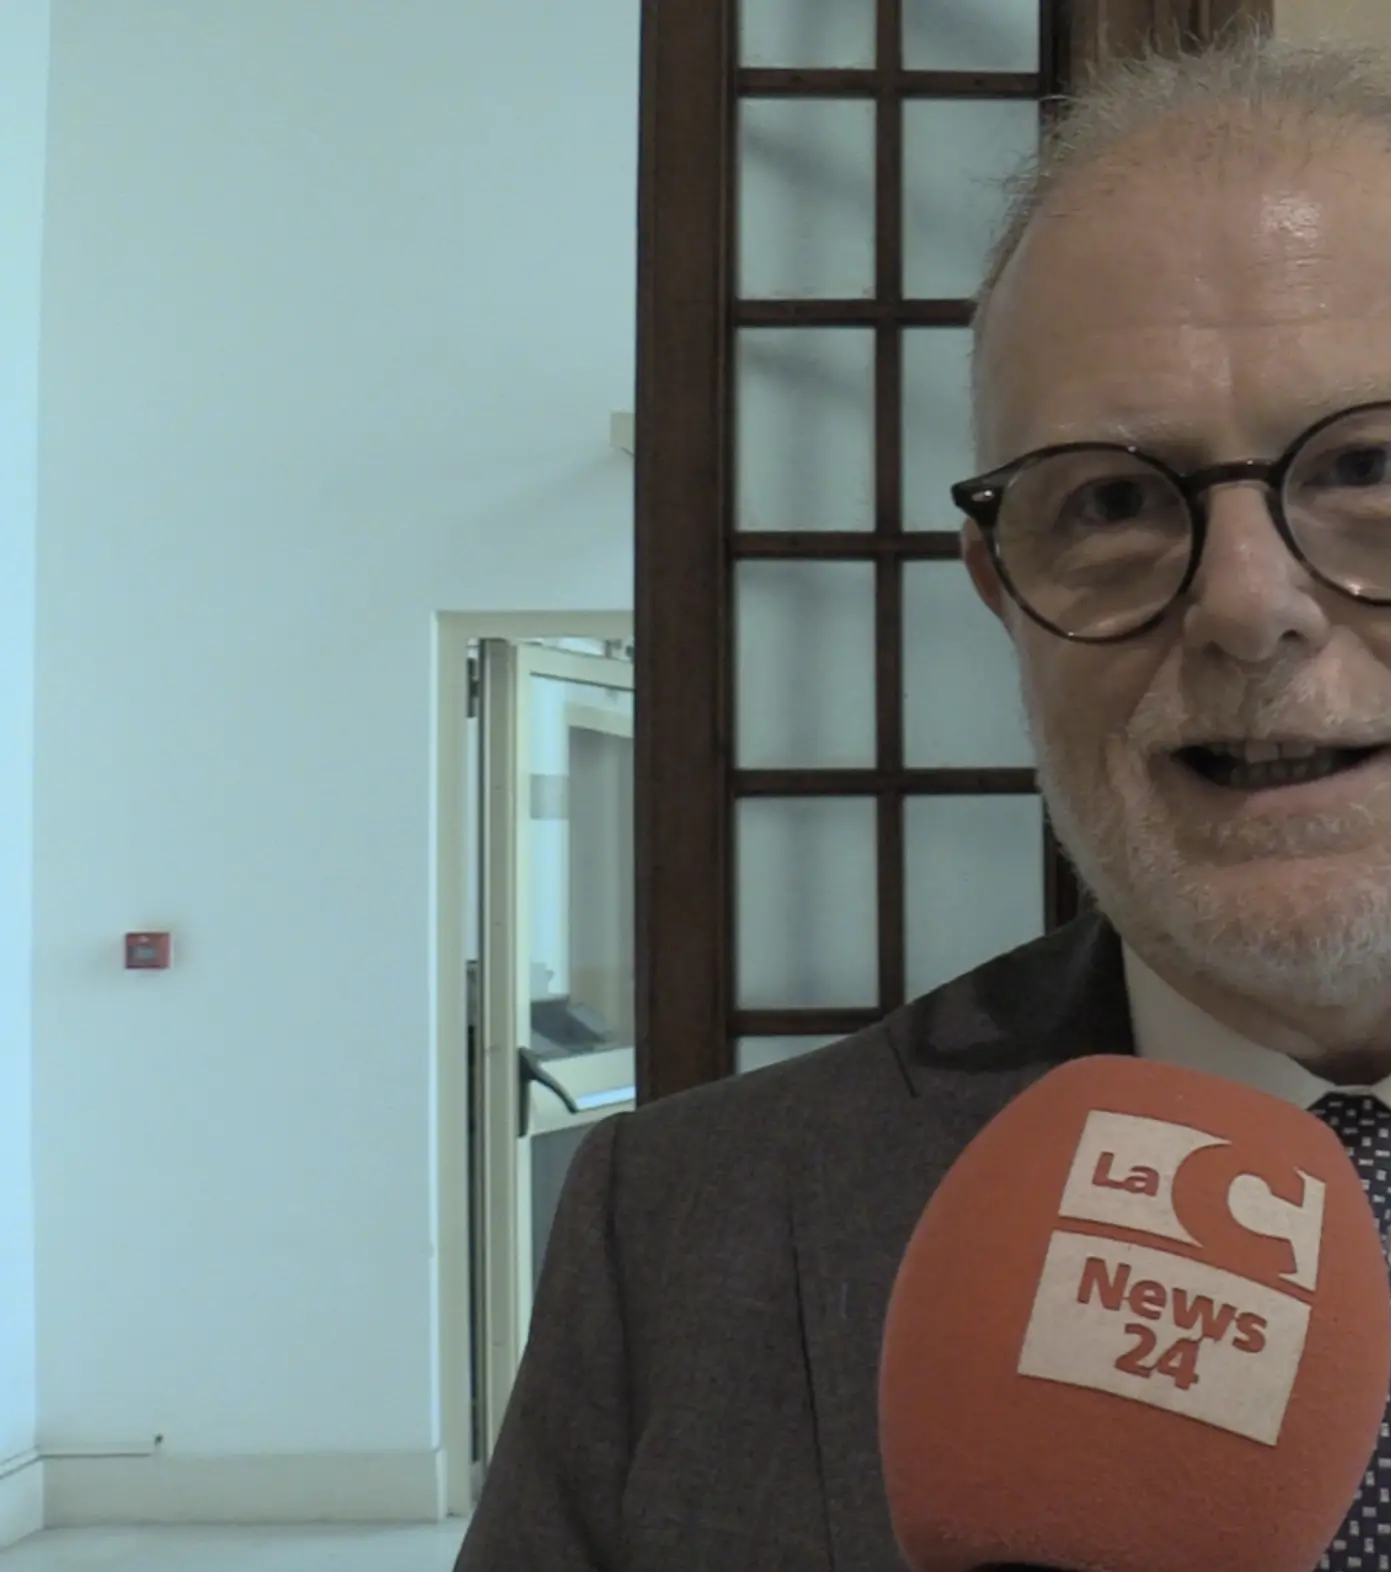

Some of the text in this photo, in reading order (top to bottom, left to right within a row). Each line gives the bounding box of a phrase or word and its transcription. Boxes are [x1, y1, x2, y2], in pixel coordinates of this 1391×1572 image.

[1092, 1151, 1159, 1197] La
[1076, 1256, 1268, 1353] News
[1114, 1323, 1199, 1391] 24
